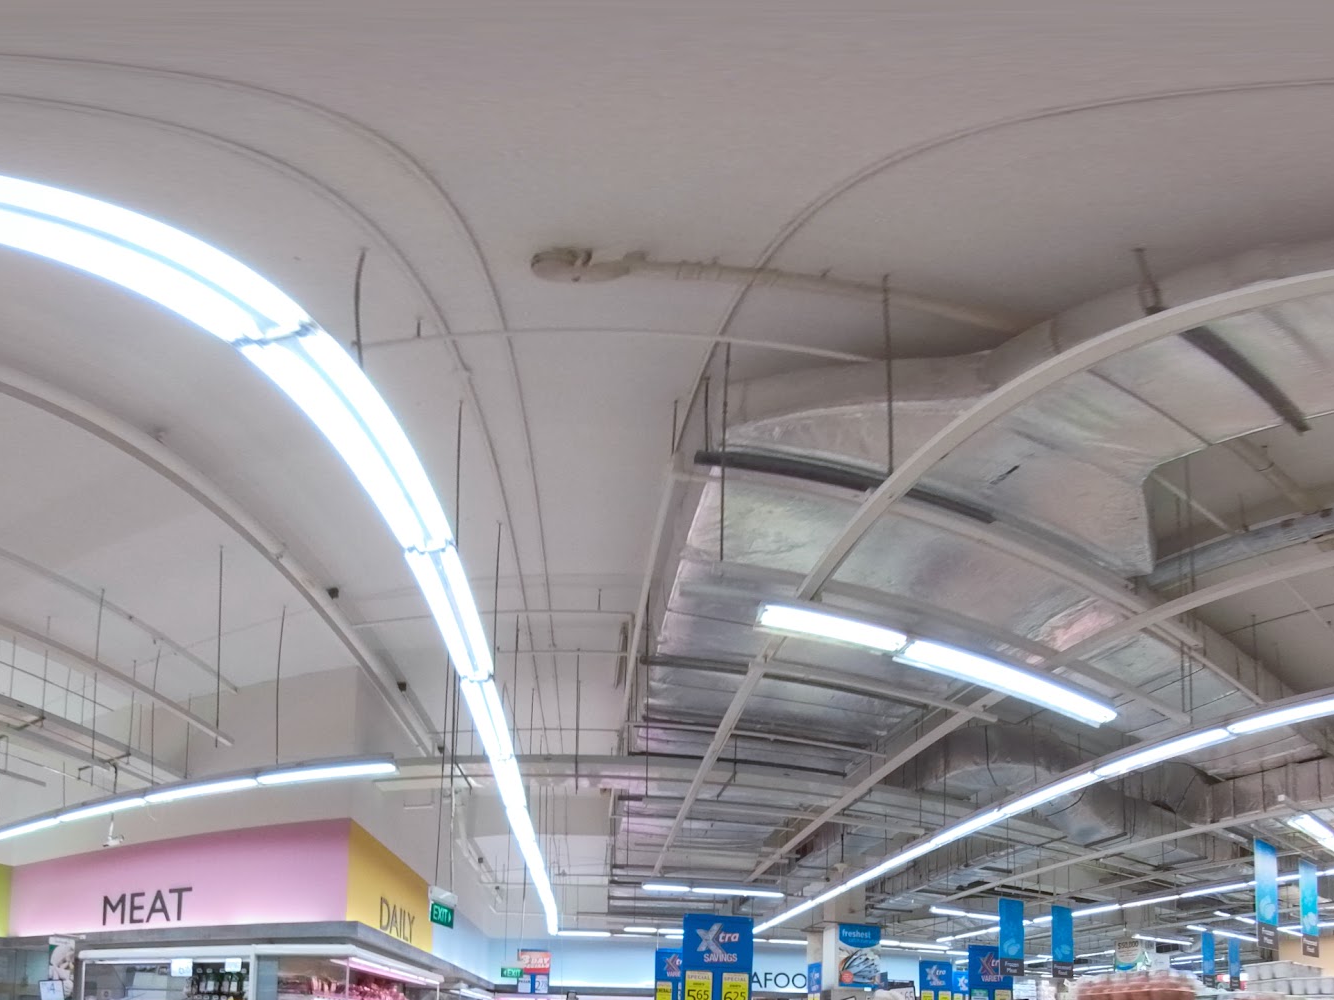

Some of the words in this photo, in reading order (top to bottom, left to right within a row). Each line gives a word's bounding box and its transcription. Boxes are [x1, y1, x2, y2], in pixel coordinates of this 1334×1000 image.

[102, 887, 193, 926] MEAT
[433, 905, 448, 923] EXIT
[380, 896, 415, 943] DAILY
[696, 923, 740, 955] Xtra
[842, 929, 872, 939] freshest
[703, 953, 738, 963] SAVINGS
[507, 969, 522, 977] EXIT
[751, 971, 807, 989] AFOO
